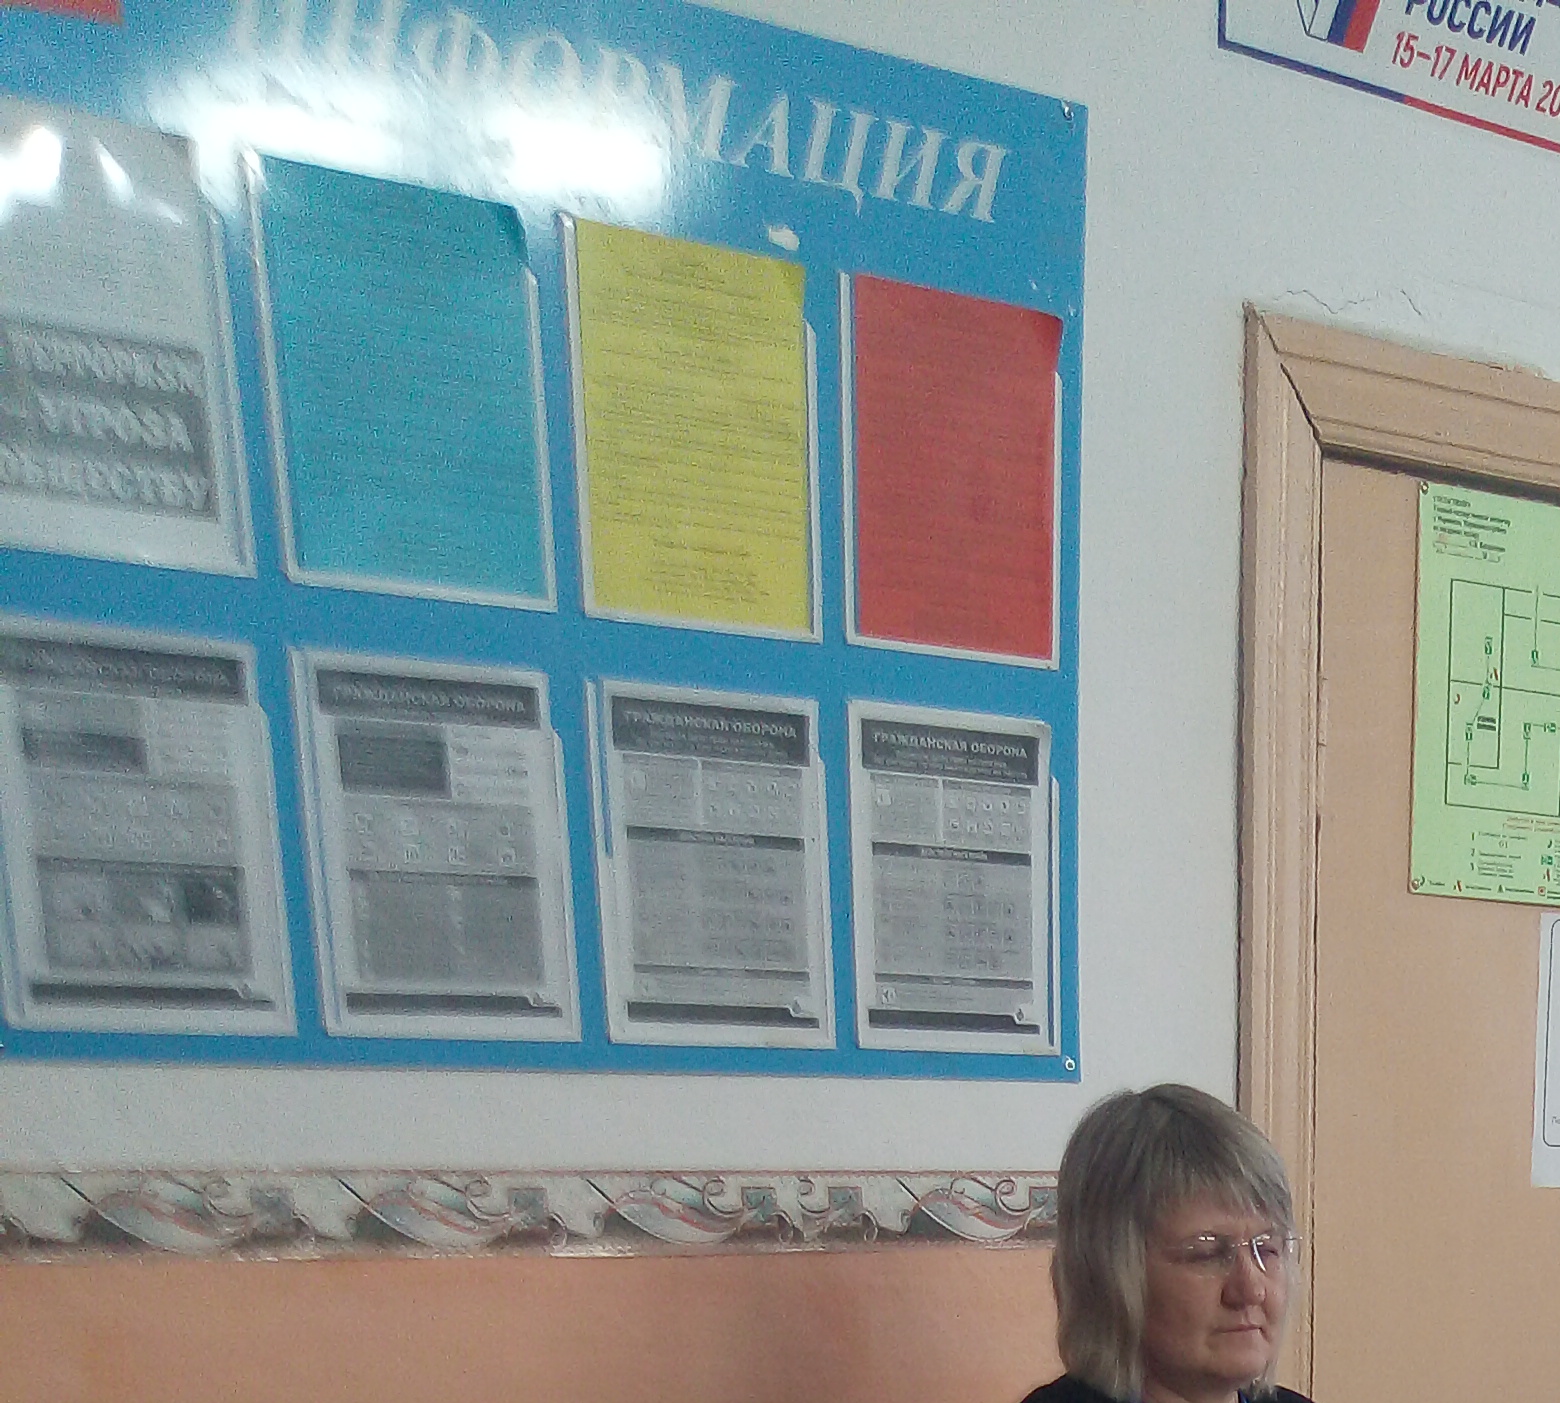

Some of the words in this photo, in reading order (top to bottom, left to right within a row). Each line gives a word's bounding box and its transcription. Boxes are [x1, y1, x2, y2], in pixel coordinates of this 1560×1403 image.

[1457, 53, 1532, 108] МАРТА
[873, 731, 968, 752] ГРАЖДАНСКАЯ
[971, 741, 1028, 759] ОБОРОНА
